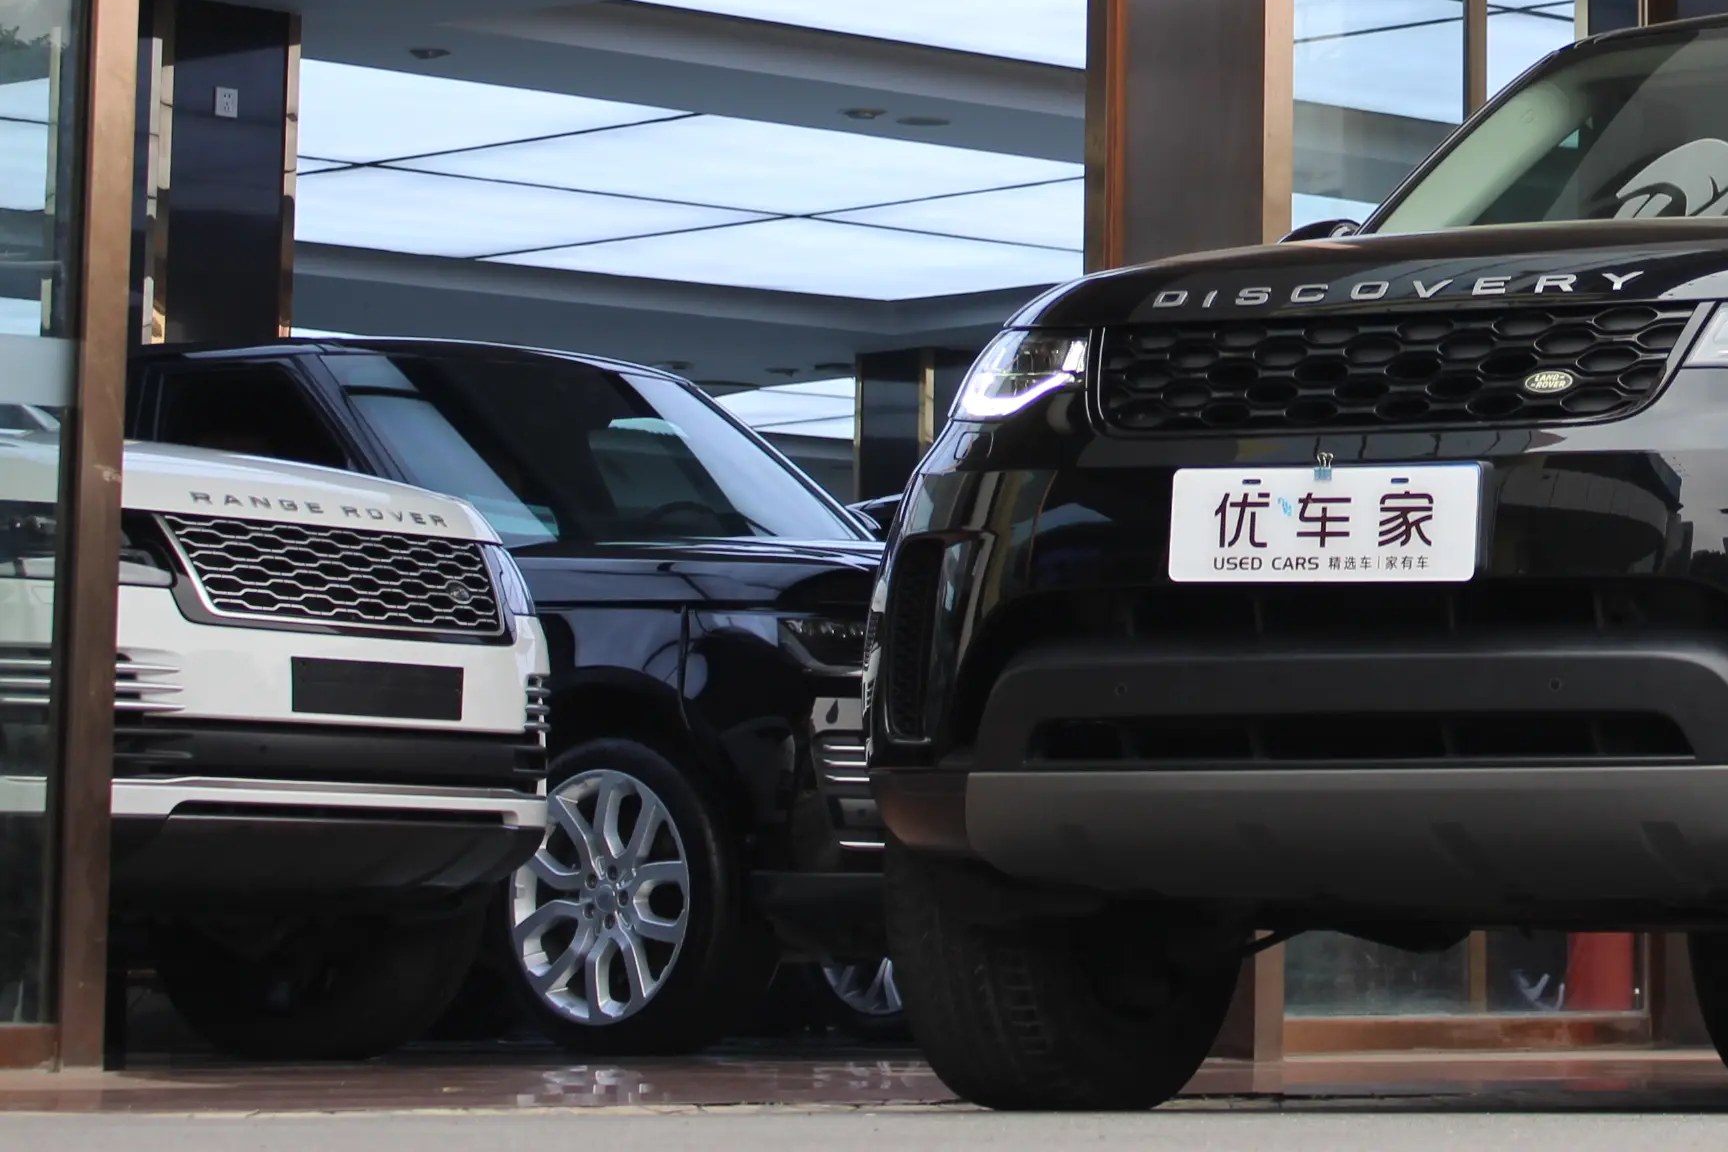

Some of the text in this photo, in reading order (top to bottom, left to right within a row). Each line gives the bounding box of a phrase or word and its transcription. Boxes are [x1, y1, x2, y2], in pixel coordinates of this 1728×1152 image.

[1152, 270, 1644, 309] DISCOVERY
[189, 490, 449, 528] RANGE ROVER
[1214, 491, 1434, 548] 优车家
[1213, 556, 1320, 571] USED CARS
